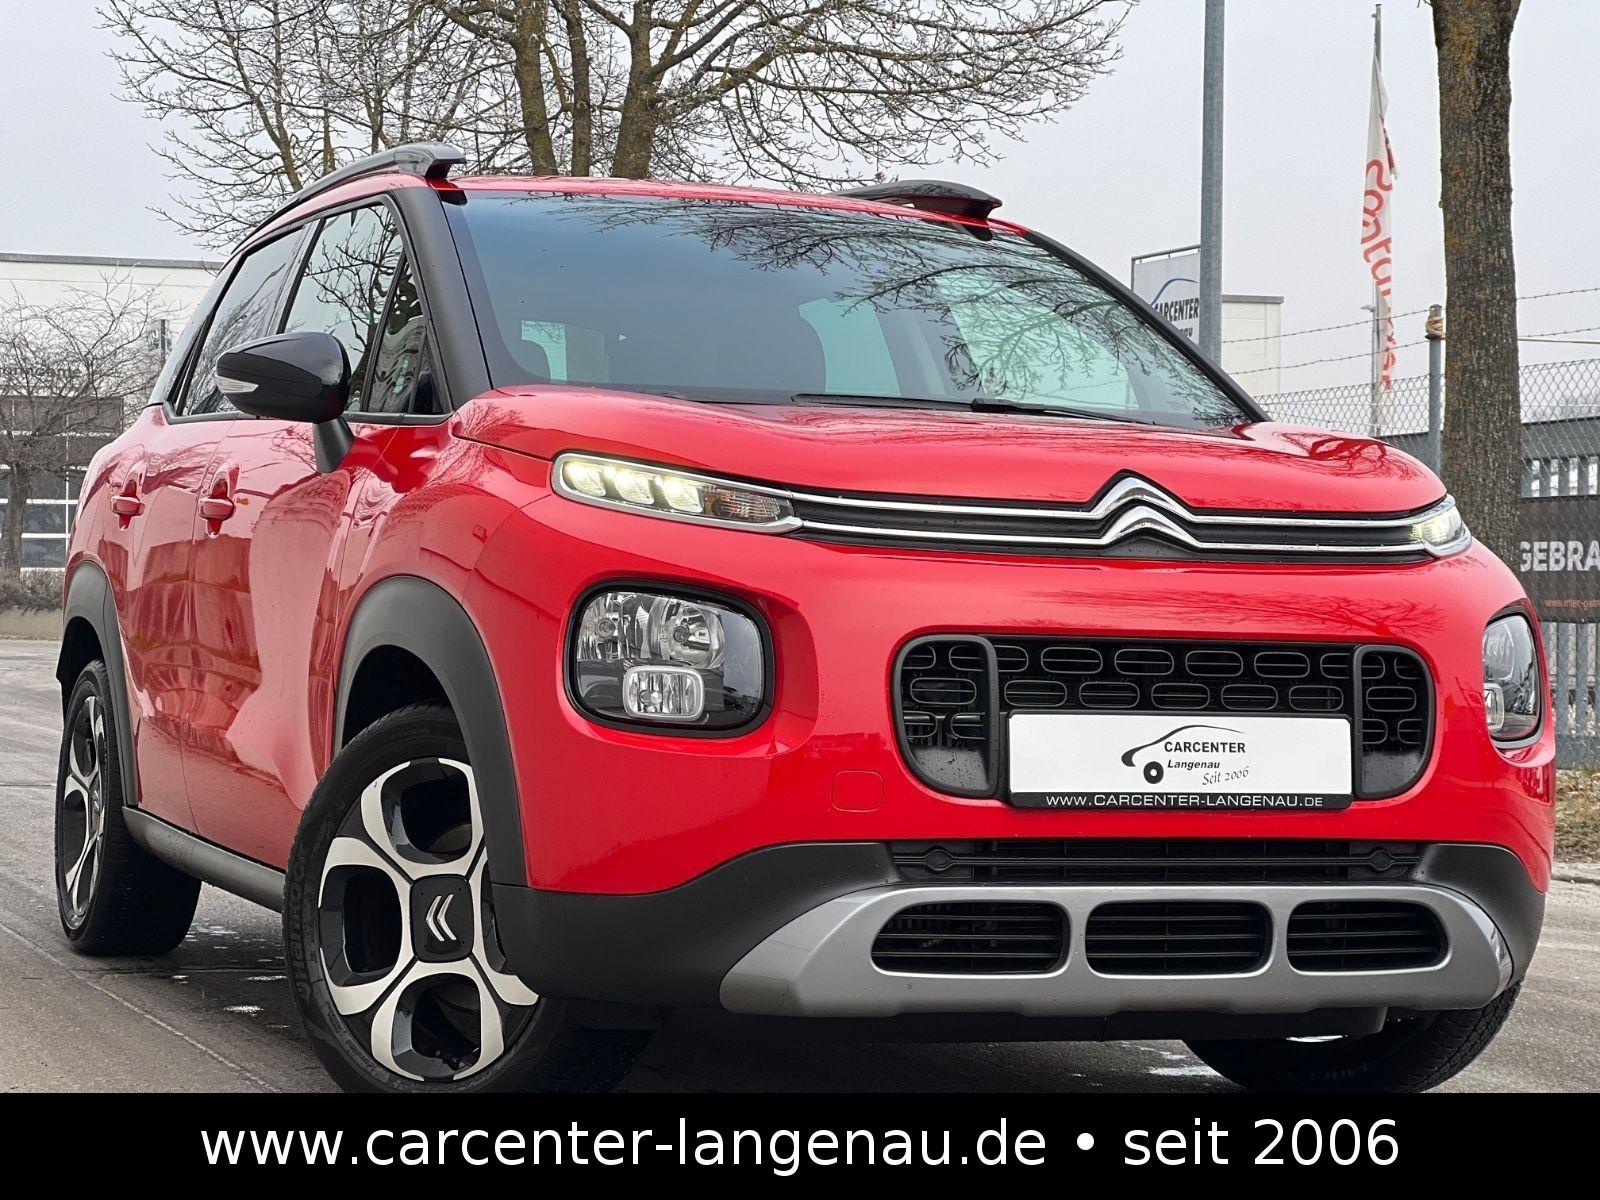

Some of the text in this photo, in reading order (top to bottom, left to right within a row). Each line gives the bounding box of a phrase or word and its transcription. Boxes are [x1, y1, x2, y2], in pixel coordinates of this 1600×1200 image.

[1164, 741, 1246, 753] CARCENTER
[1167, 760, 1221, 771] Langenau
[1202, 765, 1250, 786] Seit 2006
[1045, 794, 1323, 807] WWW.CARCENTER-LANGENAU.DE
